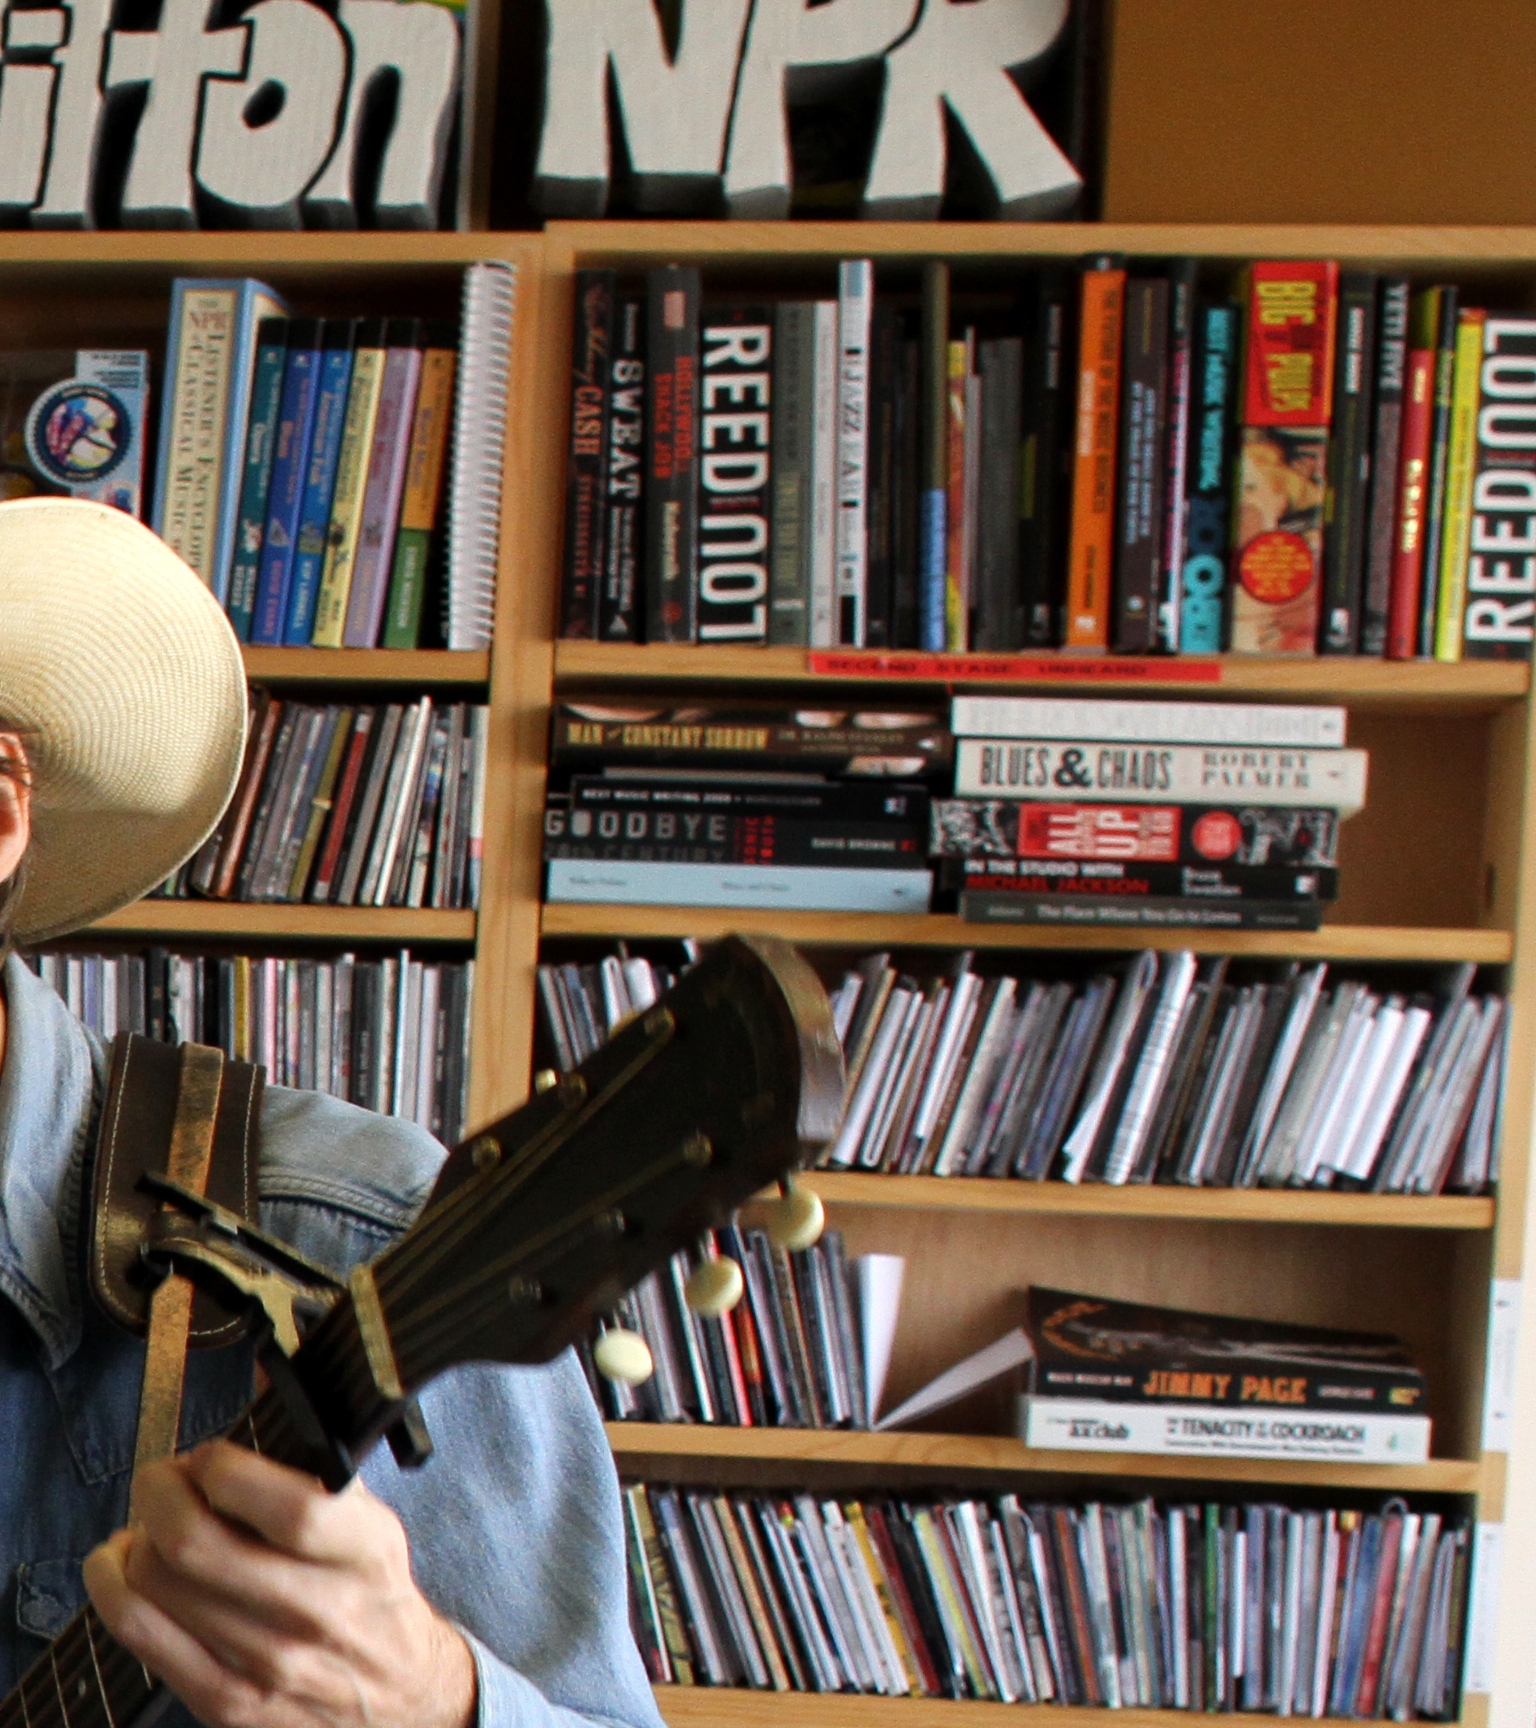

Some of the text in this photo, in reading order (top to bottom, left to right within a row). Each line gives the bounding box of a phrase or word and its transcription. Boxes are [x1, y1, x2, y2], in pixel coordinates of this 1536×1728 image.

[536, 0, 1085, 201] NPR
[1255, 282, 1317, 325] BIG
[1380, 284, 1408, 391] YETI FIVE
[1479, 319, 1536, 450] LOU
[573, 385, 603, 455] CASH
[609, 359, 645, 500] SWEAT
[702, 325, 771, 494] REED
[700, 513, 768, 641] LOU
[1465, 468, 1536, 642] REED
[567, 723, 769, 750] MAN CONSTANT SORROW
[981, 745, 1173, 791] BLUES & CHAOS
[1202, 752, 1310, 769] ROBERT
[1202, 770, 1311, 789] PALMER
[544, 809, 727, 842] GOODBYE
[1047, 813, 1086, 854] ALL
[1095, 810, 1140, 857] UP
[964, 859, 1124, 878] IN THE STUDIO WITH
[966, 875, 1151, 894] MICHAEL JACKSON
[1141, 1370, 1233, 1398] JIMMY
[1240, 1376, 1308, 1404] PAGE
[1181, 1417, 1365, 1443] TENACITY COCKROACH
